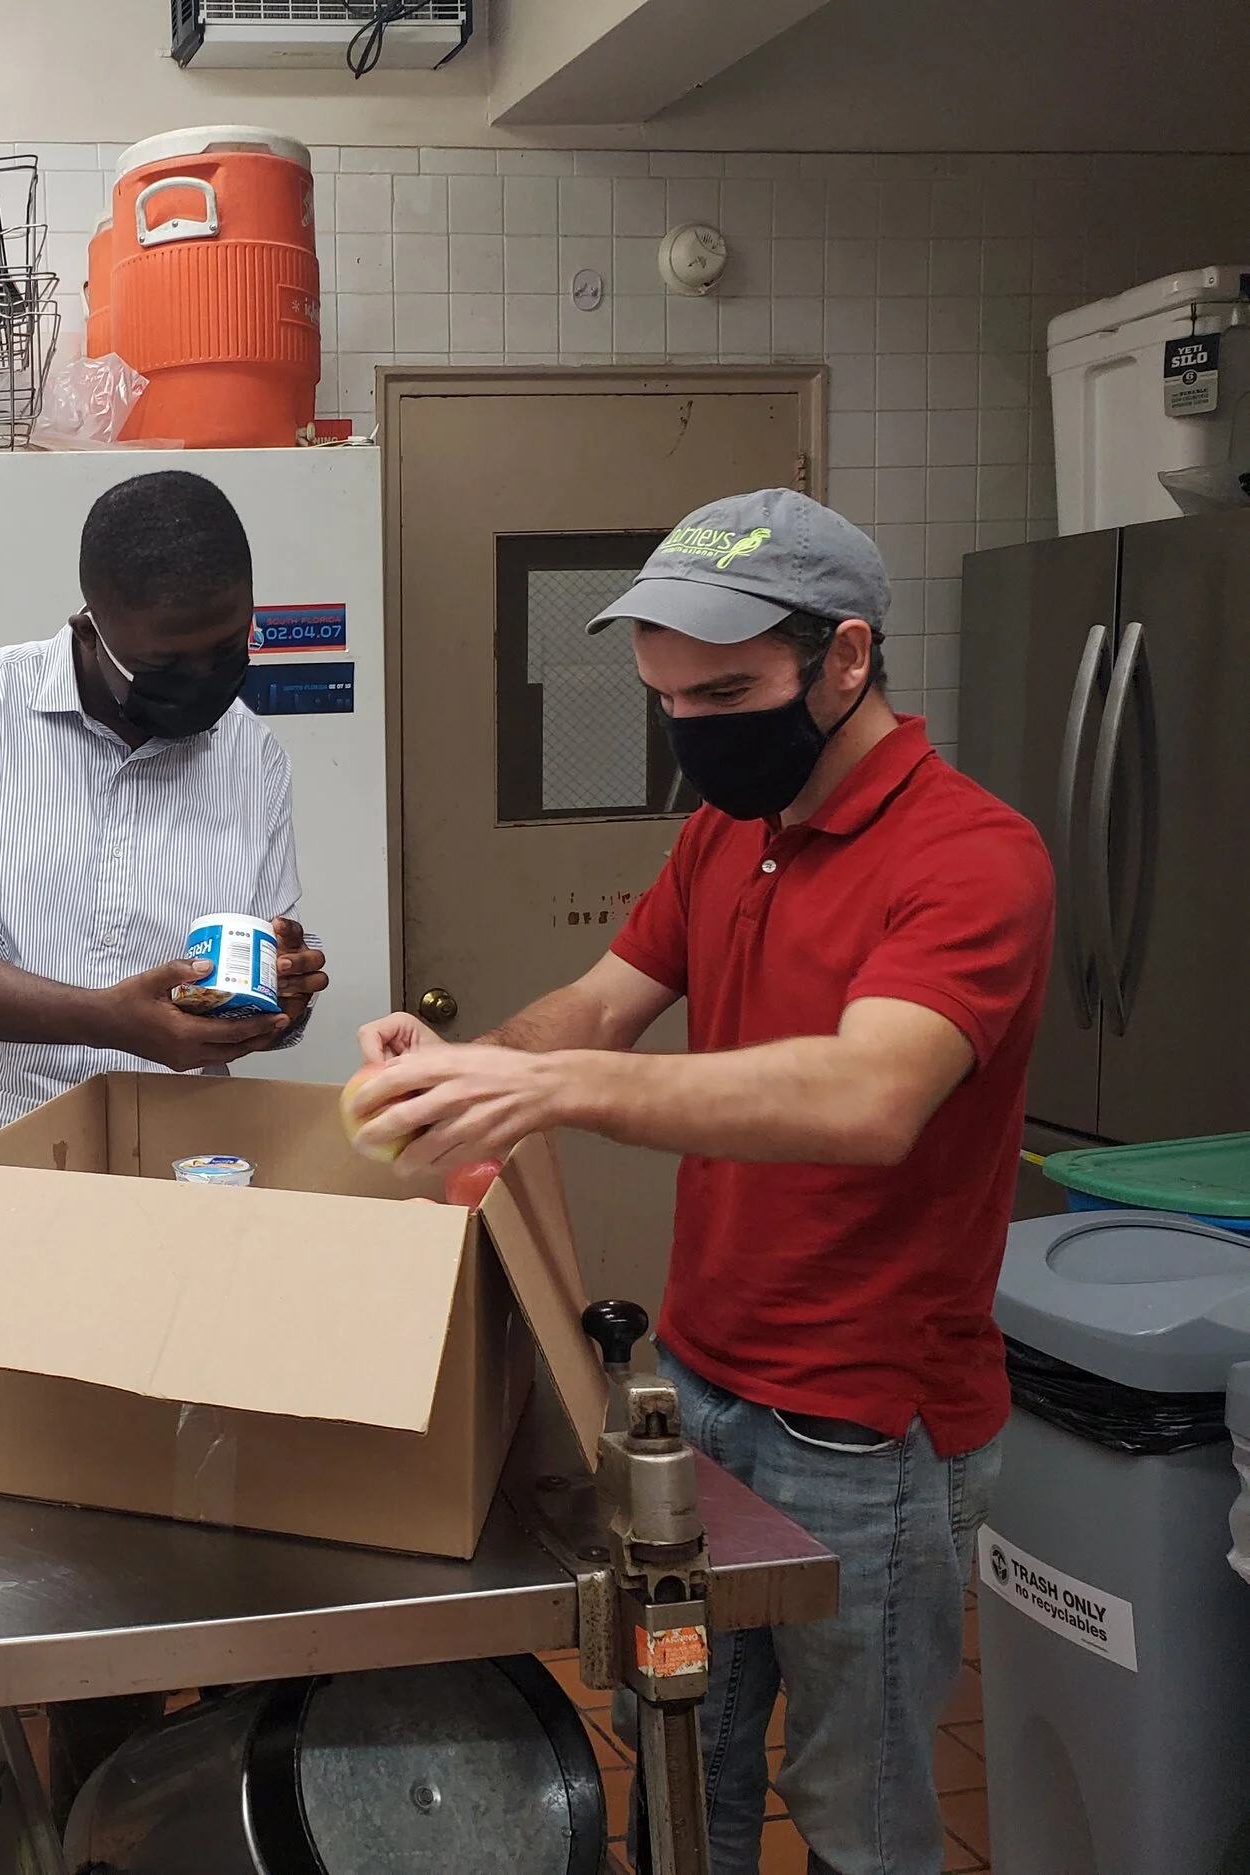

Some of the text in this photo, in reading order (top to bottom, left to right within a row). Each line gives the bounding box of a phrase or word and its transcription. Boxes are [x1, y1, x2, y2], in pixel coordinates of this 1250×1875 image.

[1178, 344, 1202, 354] YETI
[1171, 352, 1208, 368] SILO
[266, 626, 342, 640] 02.04.07
[1012, 1559, 1106, 1622] TRASH ONLY
[1015, 1583, 1029, 1599] no
[1031, 1594, 1107, 1641] recyclables
